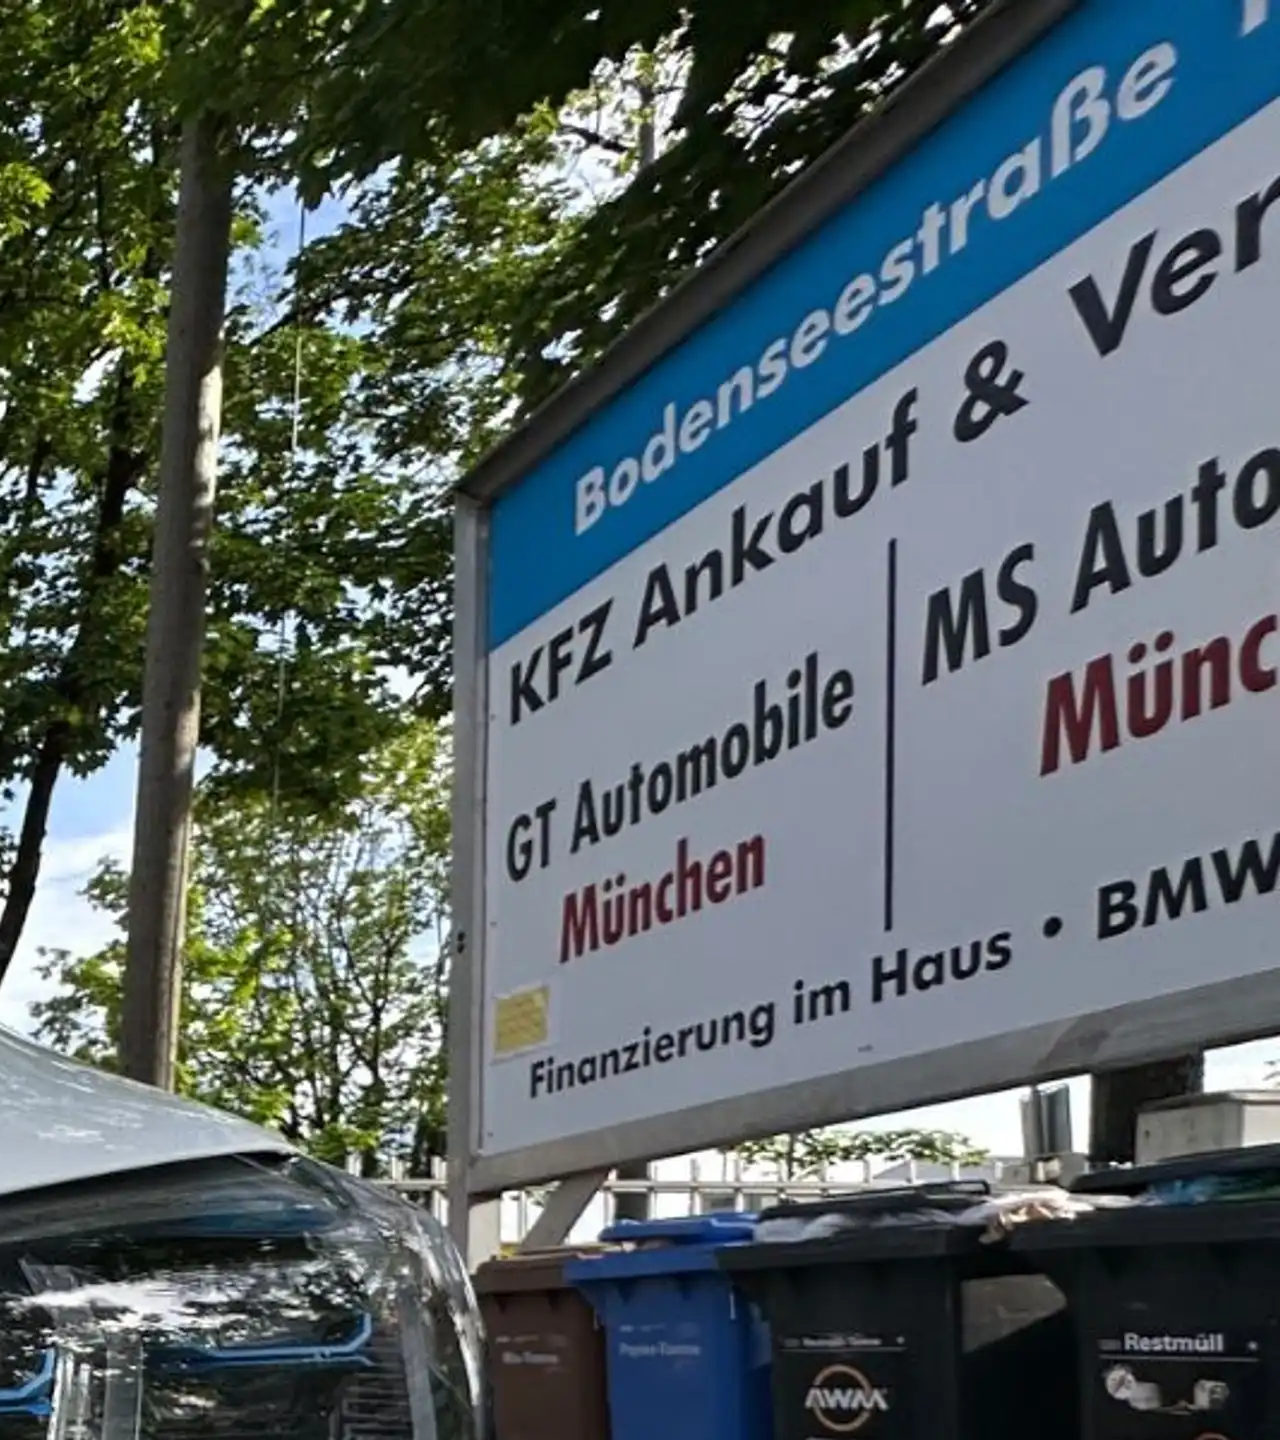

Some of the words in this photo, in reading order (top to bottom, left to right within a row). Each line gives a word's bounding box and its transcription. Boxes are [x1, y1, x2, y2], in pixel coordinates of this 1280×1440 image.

[574, 41, 1178, 537] Bodenseestraße
[510, 598, 614, 726] KFZ
[631, 386, 918, 650] Ankauf
[953, 339, 1030, 443] &
[921, 542, 1039, 687] MS
[1069, 447, 1280, 615] Auto
[506, 797, 557, 883] GT
[569, 651, 855, 855] Automobile
[1039, 614, 1279, 778] Münc
[530, 1001, 776, 1099] Finanzierung
[793, 979, 851, 1025] im
[871, 931, 1013, 1004] Haus
[1097, 831, 1280, 941] BMW
[559, 834, 765, 965] München
[804, 1386, 889, 1411] AWM
[1124, 1332, 1224, 1352] Restmüll
